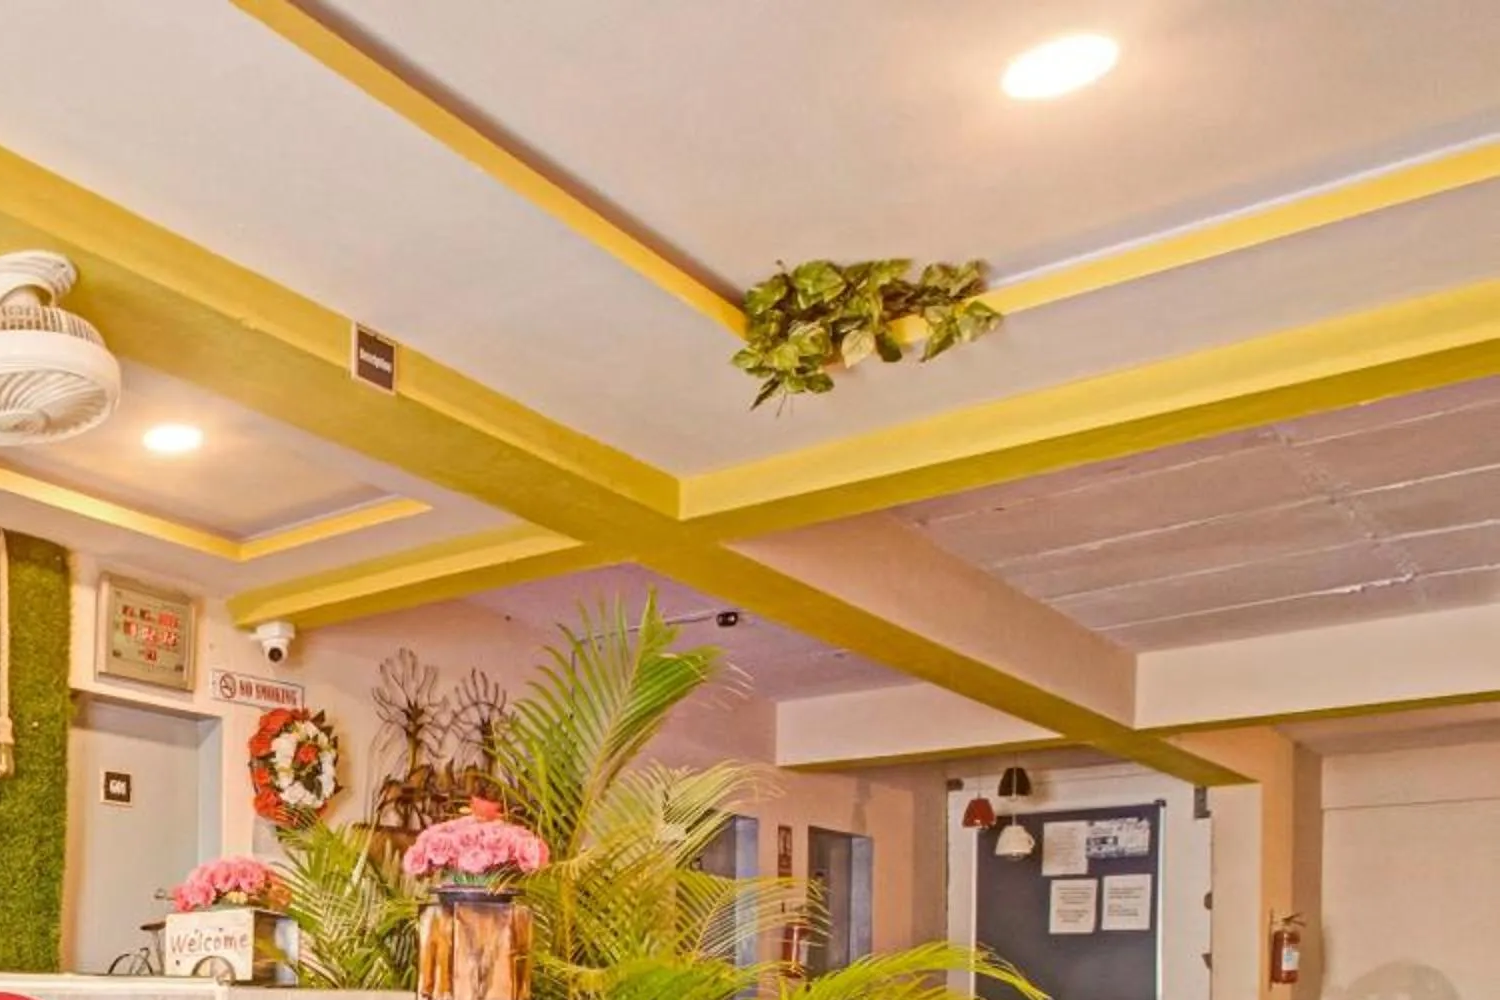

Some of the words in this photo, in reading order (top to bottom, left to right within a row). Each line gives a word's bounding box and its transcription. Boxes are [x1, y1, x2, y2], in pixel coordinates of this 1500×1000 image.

[239, 679, 253, 698] NO
[255, 683, 298, 706] SMOKING
[171, 931, 249, 953] Welcome
